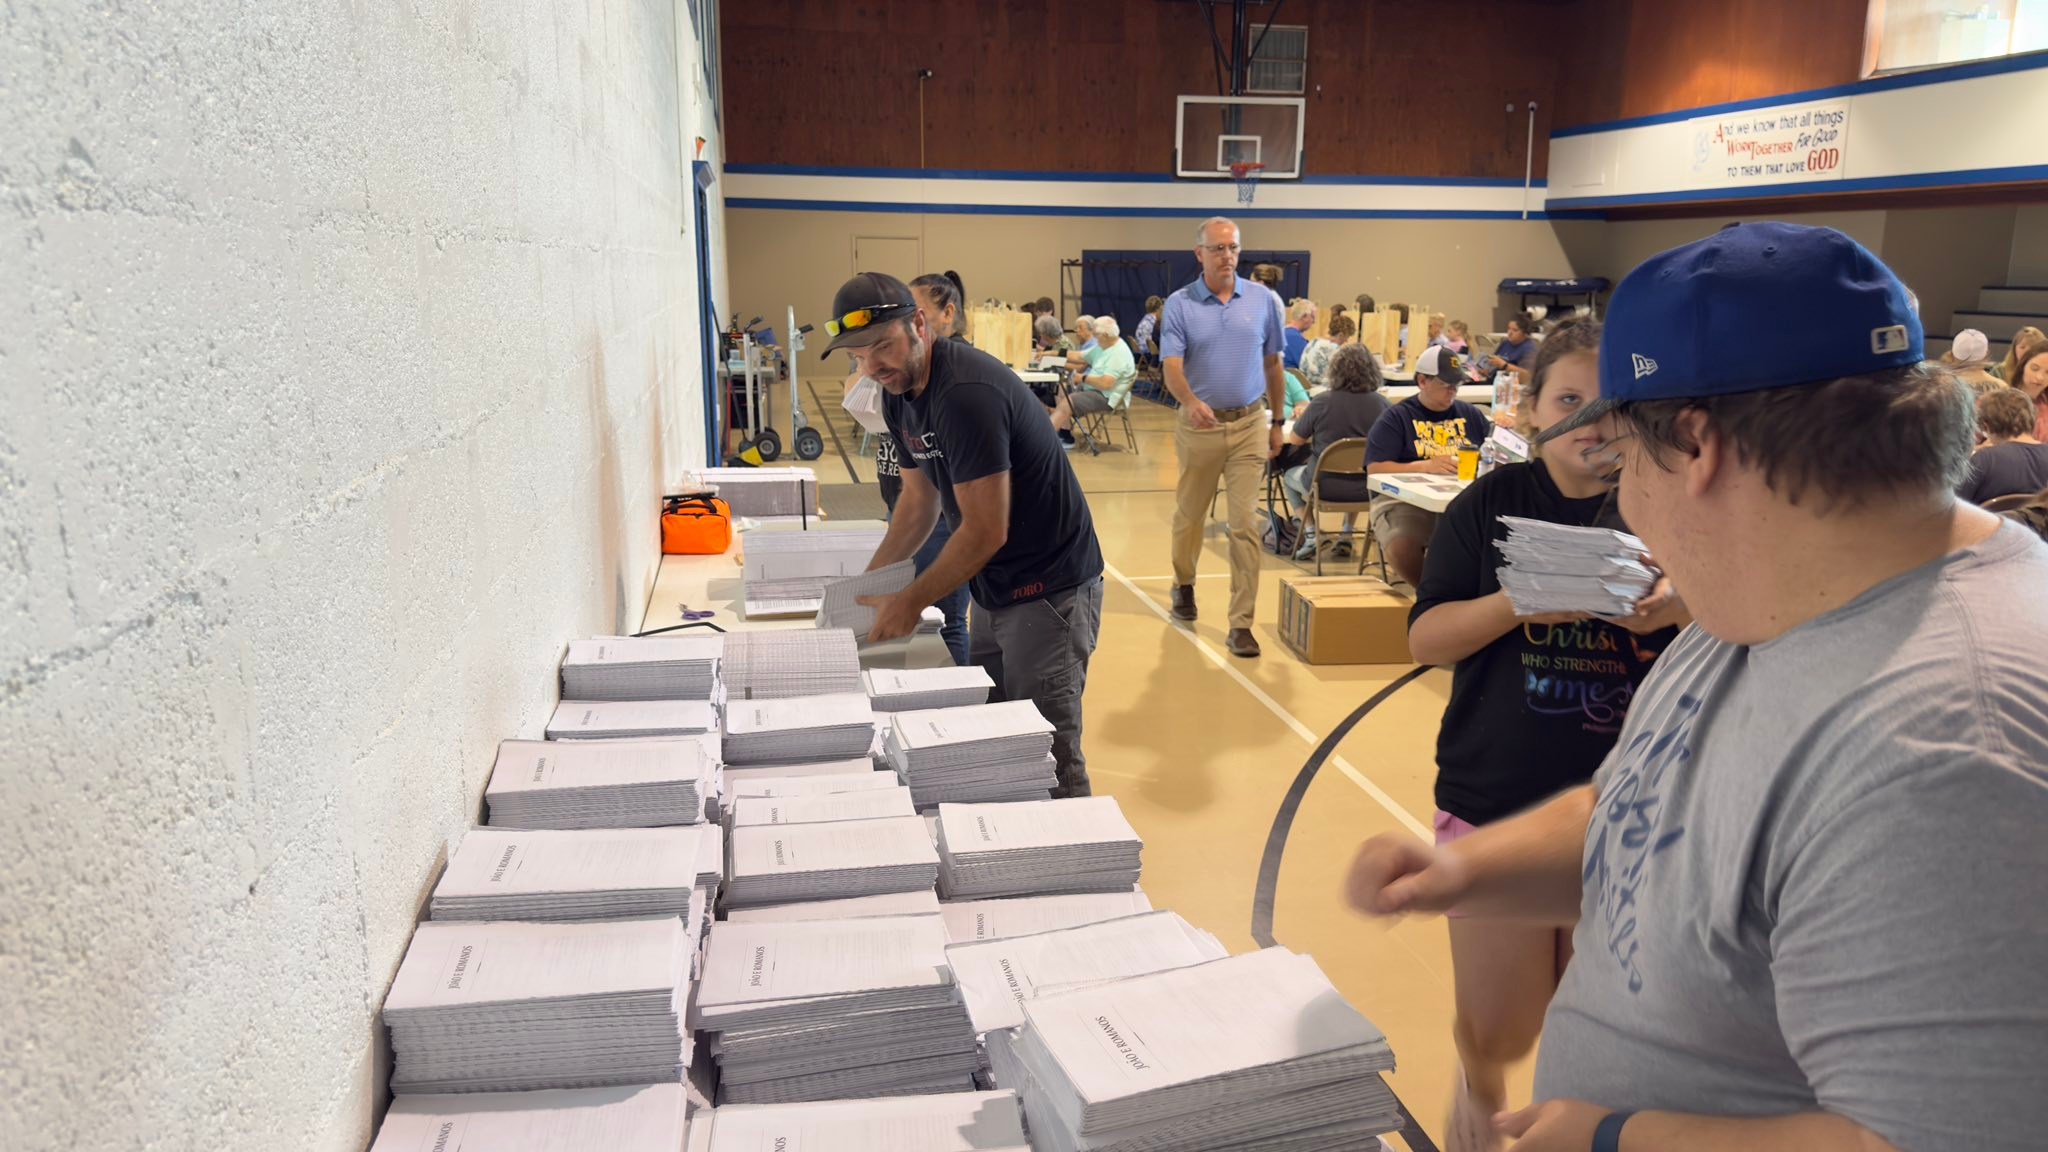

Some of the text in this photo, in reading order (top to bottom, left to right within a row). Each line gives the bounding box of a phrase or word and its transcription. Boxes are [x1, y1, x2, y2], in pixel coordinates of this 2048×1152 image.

[1737, 124, 1750, 134] we
[1753, 119, 1775, 133] know
[1780, 114, 1798, 129] that
[1800, 111, 1812, 127] all
[1814, 109, 1844, 128] things
[1727, 148, 1839, 177] TO THEM THAT LOVE GOD
[1012, 582, 1044, 600] TORO
[1521, 652, 1550, 670] WHO
[455, 945, 473, 972] ROMANOS
[753, 946, 765, 970] ROMANOS
[1095, 1016, 1128, 1048] ROMANOS
[1126, 1053, 1151, 1070] JOÃO
